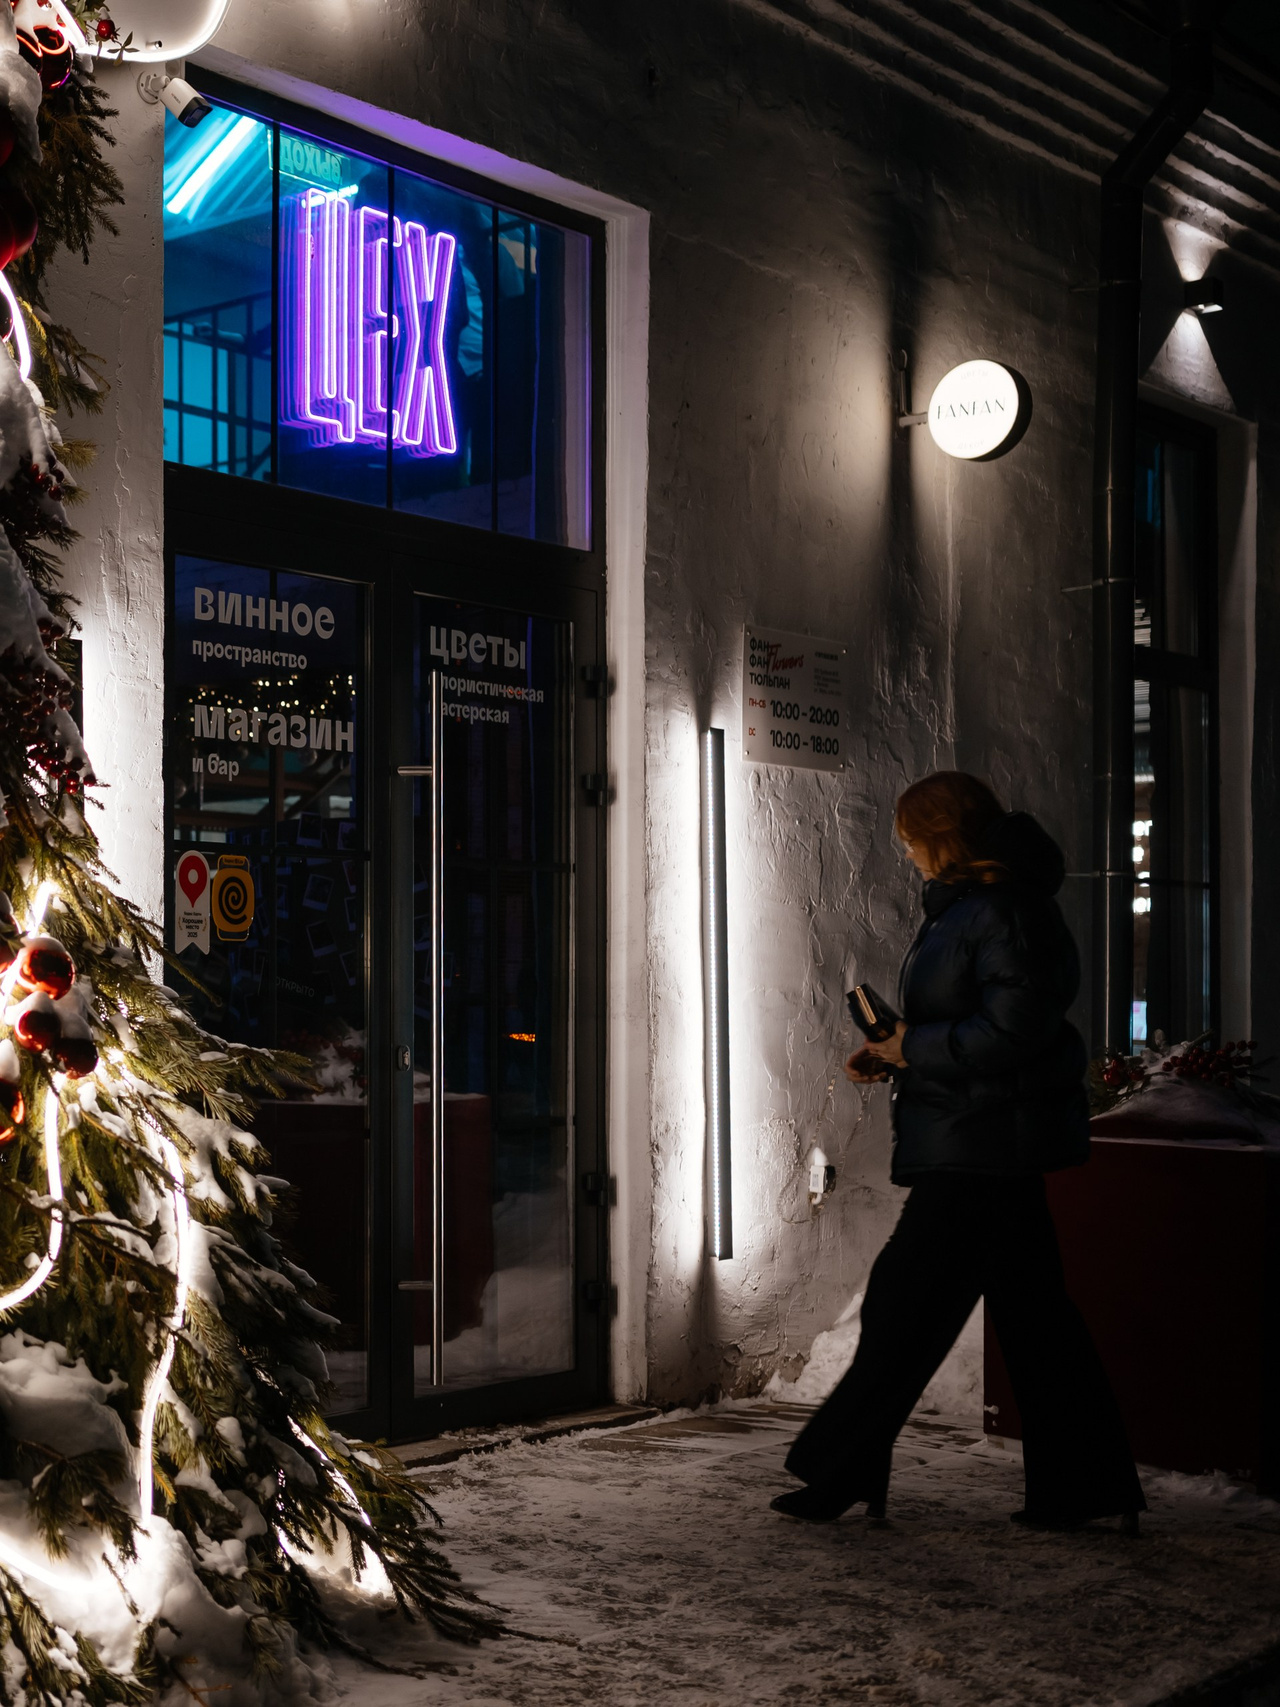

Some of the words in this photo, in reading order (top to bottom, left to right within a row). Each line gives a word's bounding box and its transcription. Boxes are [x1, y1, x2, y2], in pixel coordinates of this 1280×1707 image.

[300, 187, 457, 454] ЦЕХ
[194, 586, 335, 640] винное
[192, 639, 308, 670] пространство
[429, 625, 526, 670] цветы
[750, 637, 769, 651] ФАН
[766, 644, 804, 673] Flowers
[749, 653, 769, 669] ФАН
[428, 674, 544, 703] лористическая
[749, 672, 790, 689] ТЮЛЬПАН
[428, 700, 510, 725] астерская
[770, 700, 800, 721] 10:00
[809, 706, 839, 726] 20:00
[194, 703, 354, 753] магазин
[770, 729, 800, 750] 10:00
[810, 735, 839, 756] 18:00
[192, 757, 204, 773] и
[207, 753, 240, 782] бар
